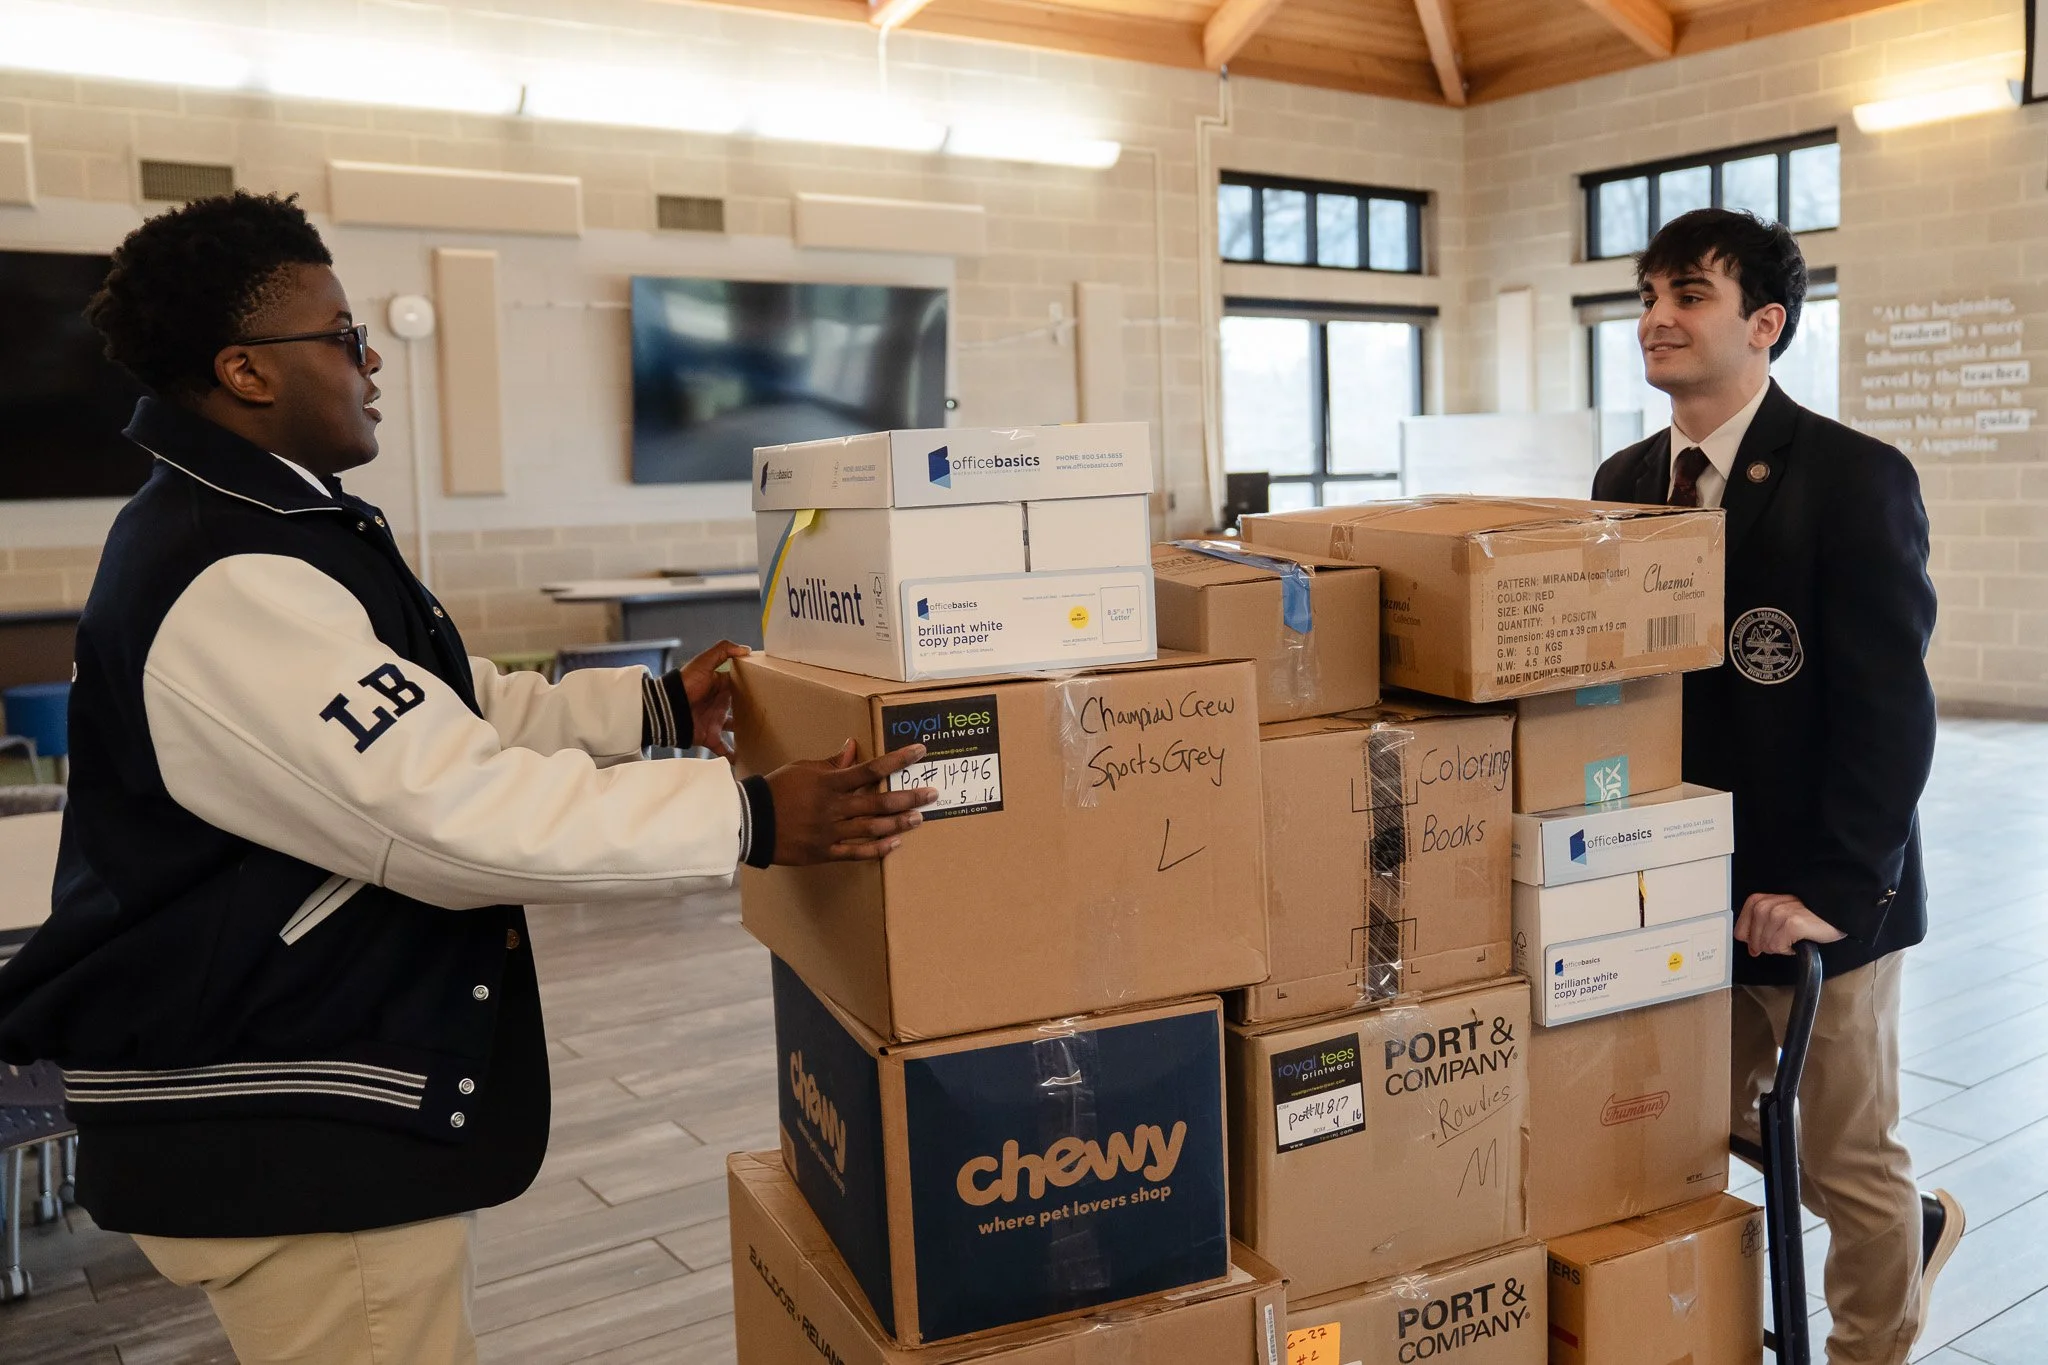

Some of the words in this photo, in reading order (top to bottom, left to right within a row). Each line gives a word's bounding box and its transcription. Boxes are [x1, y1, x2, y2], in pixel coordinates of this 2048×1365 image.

[952, 453, 1040, 470] officebasics
[1497, 577, 1538, 590] PATTERN:
[1543, 571, 1586, 584] MIRANDA
[1643, 563, 1694, 593] Chezmoi
[786, 576, 865, 626] brilliant
[930, 601, 978, 611] officebasics
[1497, 592, 1530, 604] COLOR:
[1535, 590, 1555, 602] RED
[1672, 589, 1705, 602] Collection
[1110, 614, 1130, 622] Letter
[1497, 606, 1520, 618] SIZE:
[1523, 603, 1545, 616] KING
[918, 623, 966, 636] brilliant
[969, 621, 1003, 633] white
[1497, 617, 1542, 632] QUANTITY:
[1497, 632, 1544, 645] Dimension:
[1546, 629, 1554, 638] 49
[1556, 630, 1568, 638] cm
[1576, 626, 1585, 634] 39
[1586, 626, 1598, 634] cm
[1606, 622, 1614, 631] 19
[1616, 621, 1627, 630] cm
[918, 636, 949, 648] copy
[953, 634, 989, 646] paper
[1526, 646, 1540, 656] 5.0
[1545, 642, 1563, 652] KGS
[1496, 674, 1521, 686] MADE
[1523, 672, 1532, 682] IN
[1533, 668, 1559, 681] CHINA
[1560, 665, 1580, 677] SHIP
[1581, 663, 1592, 674] TO
[1592, 660, 1616, 672] U.S.A.
[1525, 658, 1538, 668] 4.5
[1544, 655, 1562, 666] KGS
[319, 662, 425, 754] LB
[1180, 691, 1235, 718] Crew
[892, 714, 941, 740] royal
[947, 711, 991, 728] tees
[922, 726, 990, 743] printwear
[1088, 743, 1161, 792] Sports
[1162, 739, 1226, 787] Grey
[1420, 744, 1511, 792] Coloring
[1158, 818, 1207, 872] L
[1422, 814, 1486, 853] Books
[1587, 829, 1652, 849] officebasics
[1554, 976, 1590, 990] brilliant
[1593, 972, 1618, 983] white
[1554, 989, 1578, 1000] copy
[1580, 982, 1607, 996] paper
[1384, 1021, 1484, 1070] PORT
[1490, 1016, 1514, 1045] &
[1278, 1055, 1316, 1080] royal
[1320, 1048, 1354, 1066] tees
[1302, 1060, 1354, 1082] printwear
[790, 1050, 846, 1174] chewy
[956, 1120, 1187, 1206] chewy
[1456, 1137, 1497, 1198] M
[978, 1212, 1036, 1236] where
[1040, 1205, 1070, 1229] pet
[1073, 1192, 1127, 1218] lovers
[1130, 1184, 1172, 1210] shop
[749, 1244, 796, 1321] BALDOR
[1398, 1283, 1496, 1340] PORT
[1501, 1277, 1528, 1306] &
